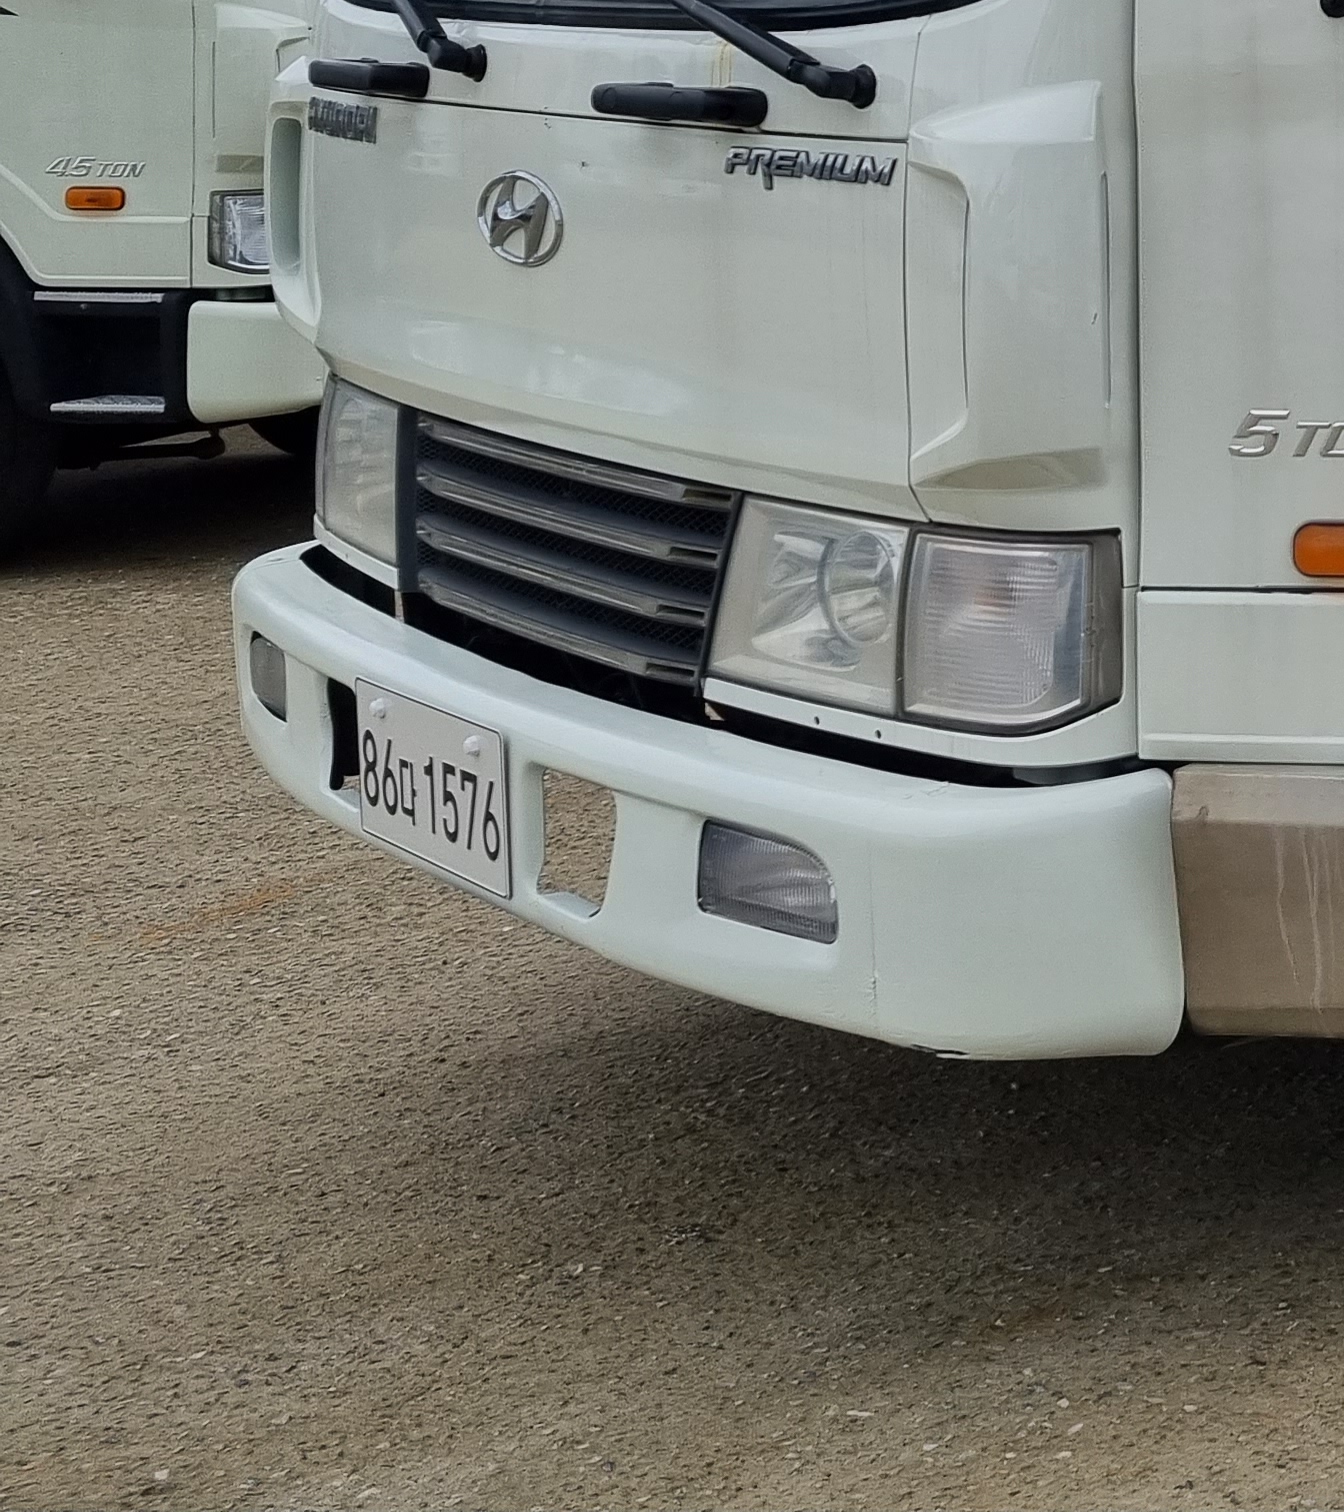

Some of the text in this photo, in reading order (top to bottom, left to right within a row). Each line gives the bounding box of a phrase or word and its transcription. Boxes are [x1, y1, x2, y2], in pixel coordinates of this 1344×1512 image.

[96, 161, 147, 178] TON
[724, 145, 898, 191] PREMIUM
[1228, 408, 1291, 458] 5
[423, 756, 501, 862] 1576
